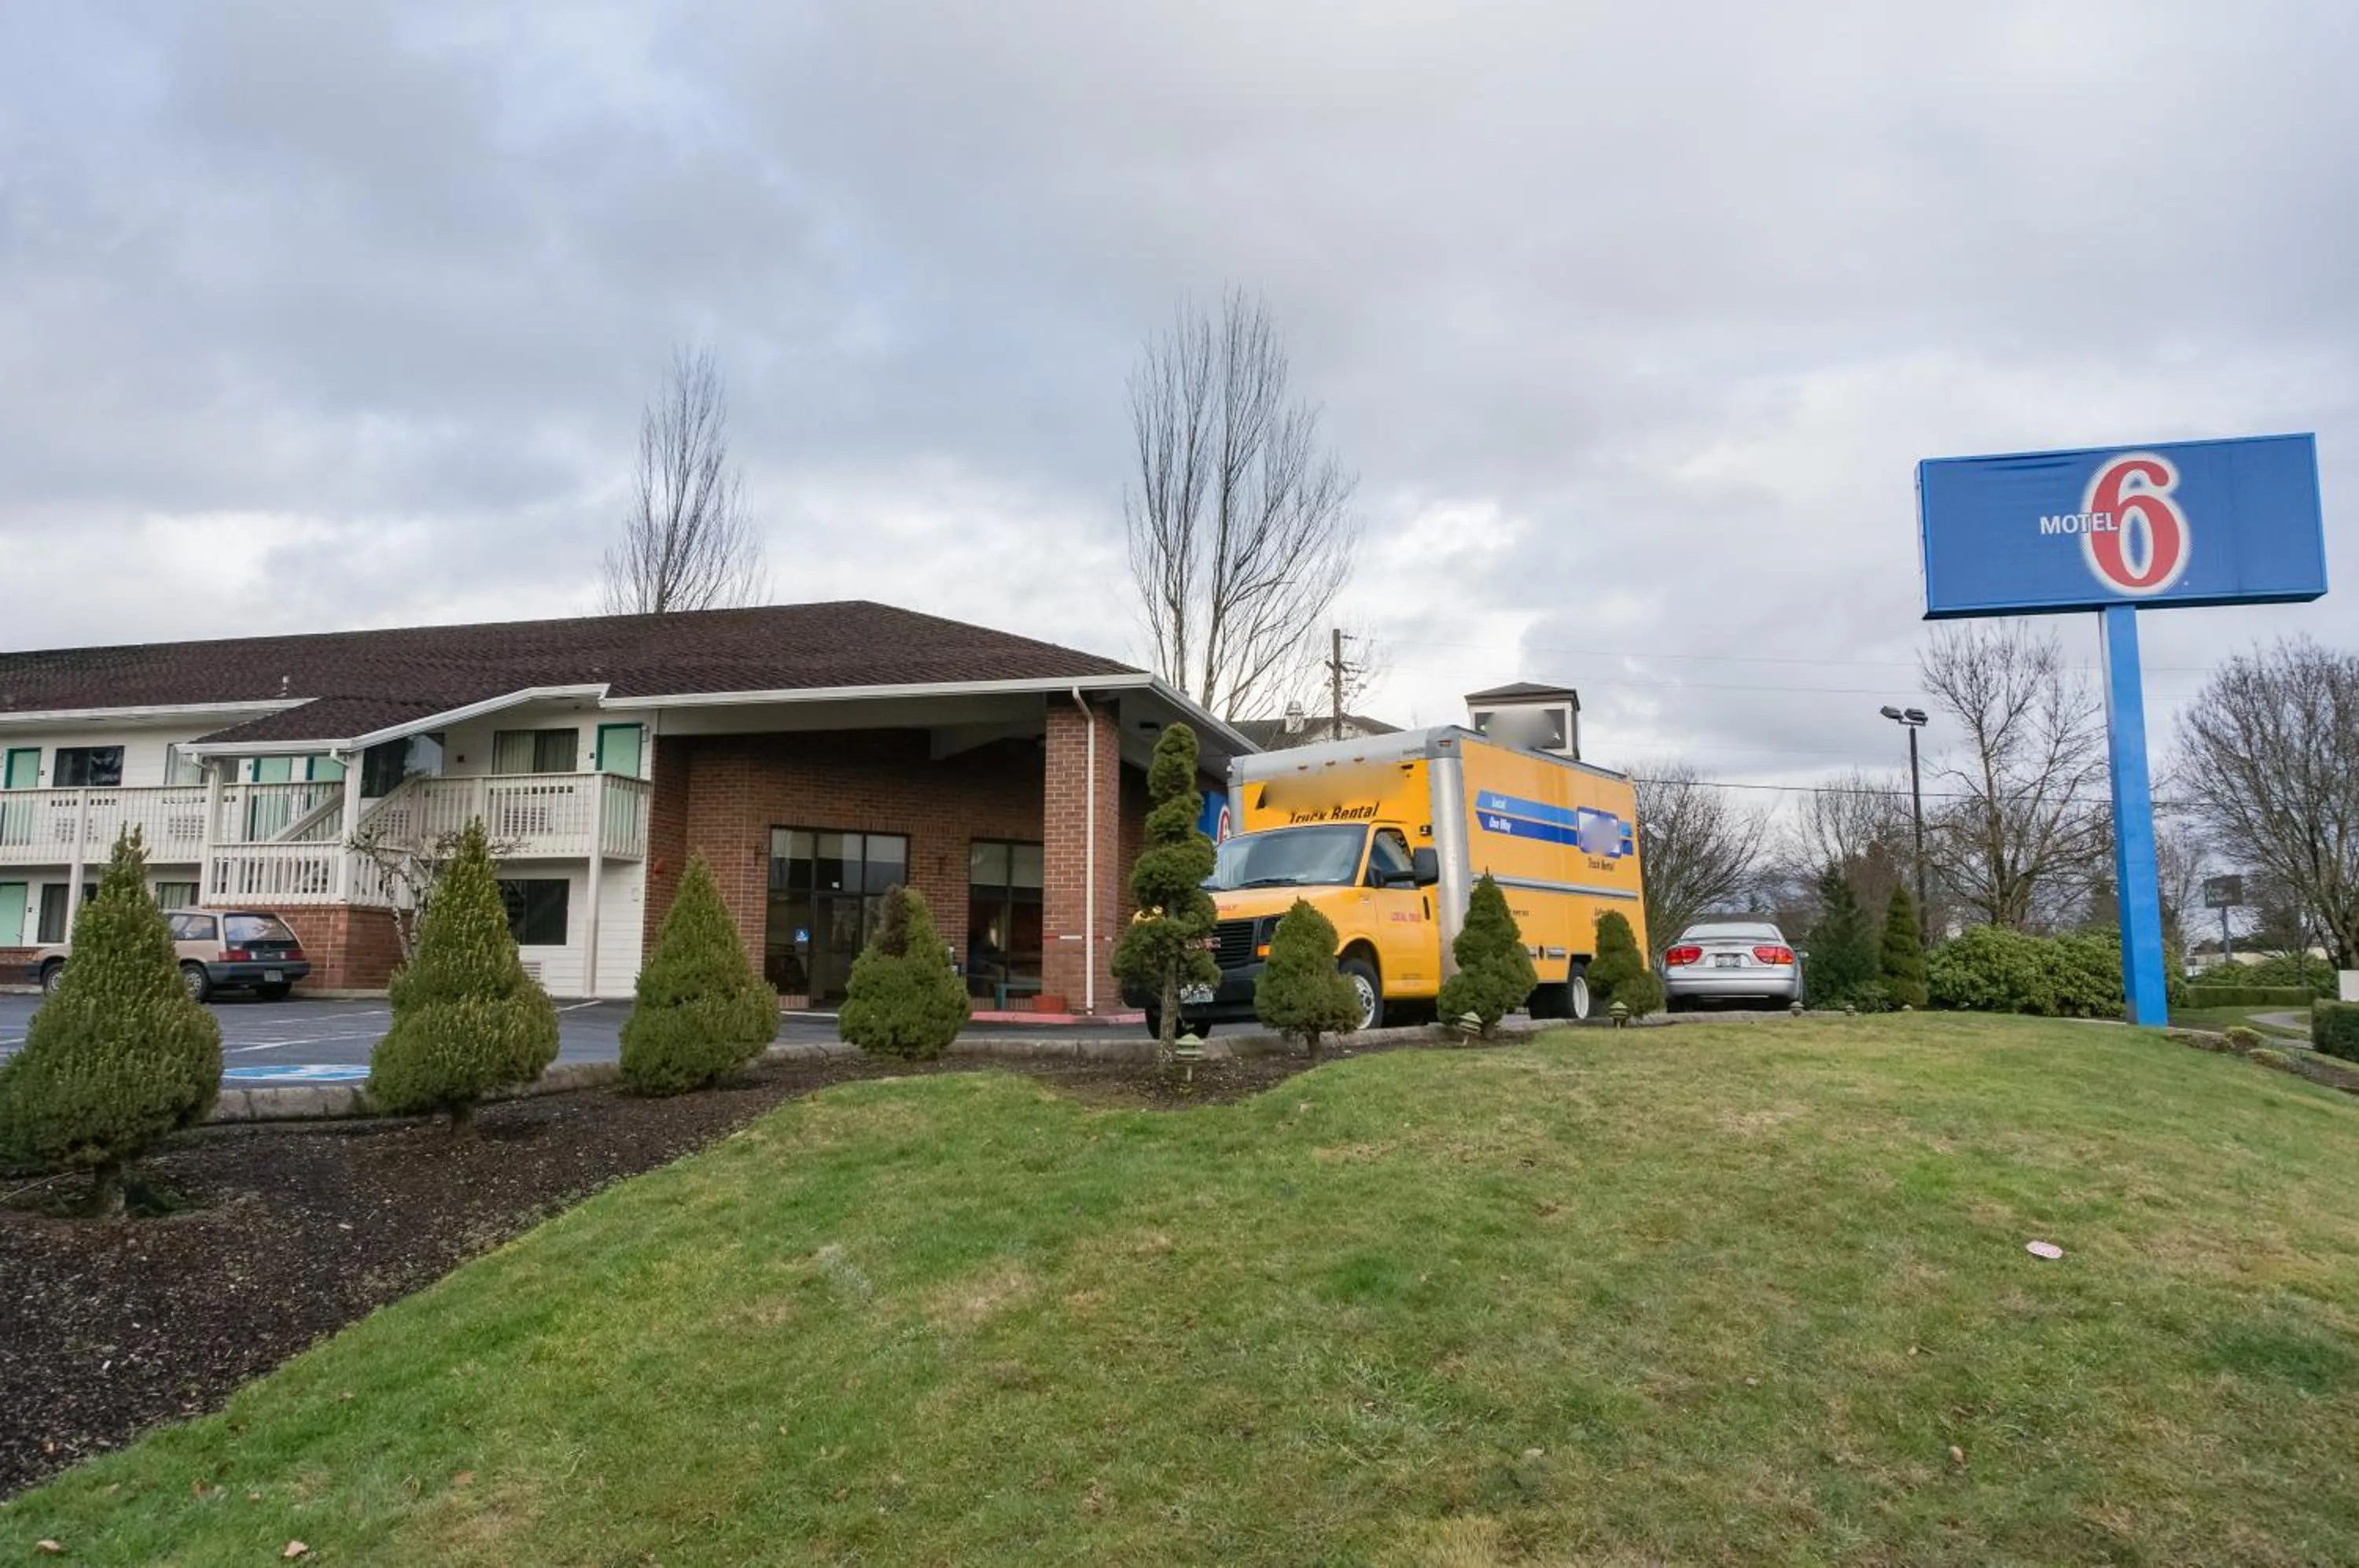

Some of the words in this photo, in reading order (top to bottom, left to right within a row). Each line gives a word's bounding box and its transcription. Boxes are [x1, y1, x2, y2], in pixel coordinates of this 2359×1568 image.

[2040, 512, 2119, 535] MOTEL
[2086, 456, 2184, 591] 6
[1330, 801, 1380, 819] Rental
